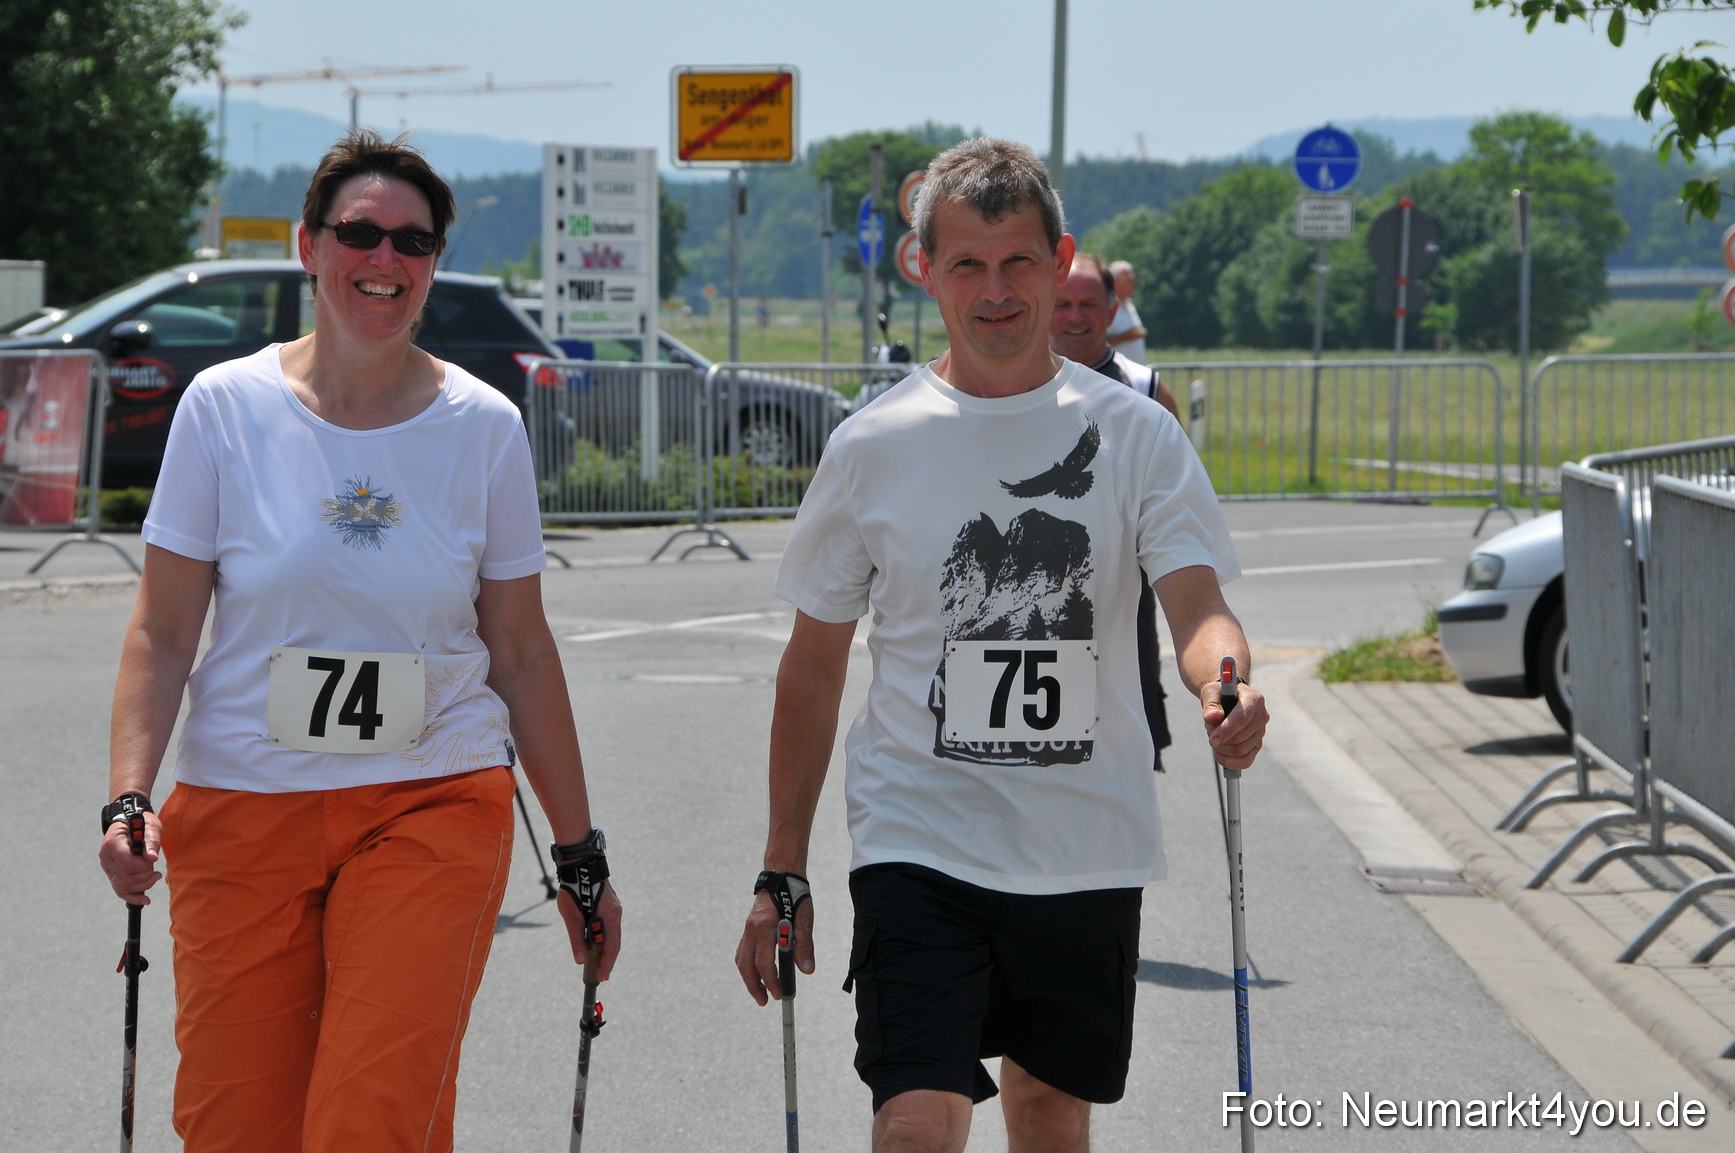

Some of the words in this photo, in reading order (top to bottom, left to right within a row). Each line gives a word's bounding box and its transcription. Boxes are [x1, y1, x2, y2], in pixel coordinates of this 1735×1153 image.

[307, 655, 384, 741] 74
[983, 649, 1061, 731] 75
[580, 867, 591, 908] LEKI
[780, 891, 792, 918] LEKI
